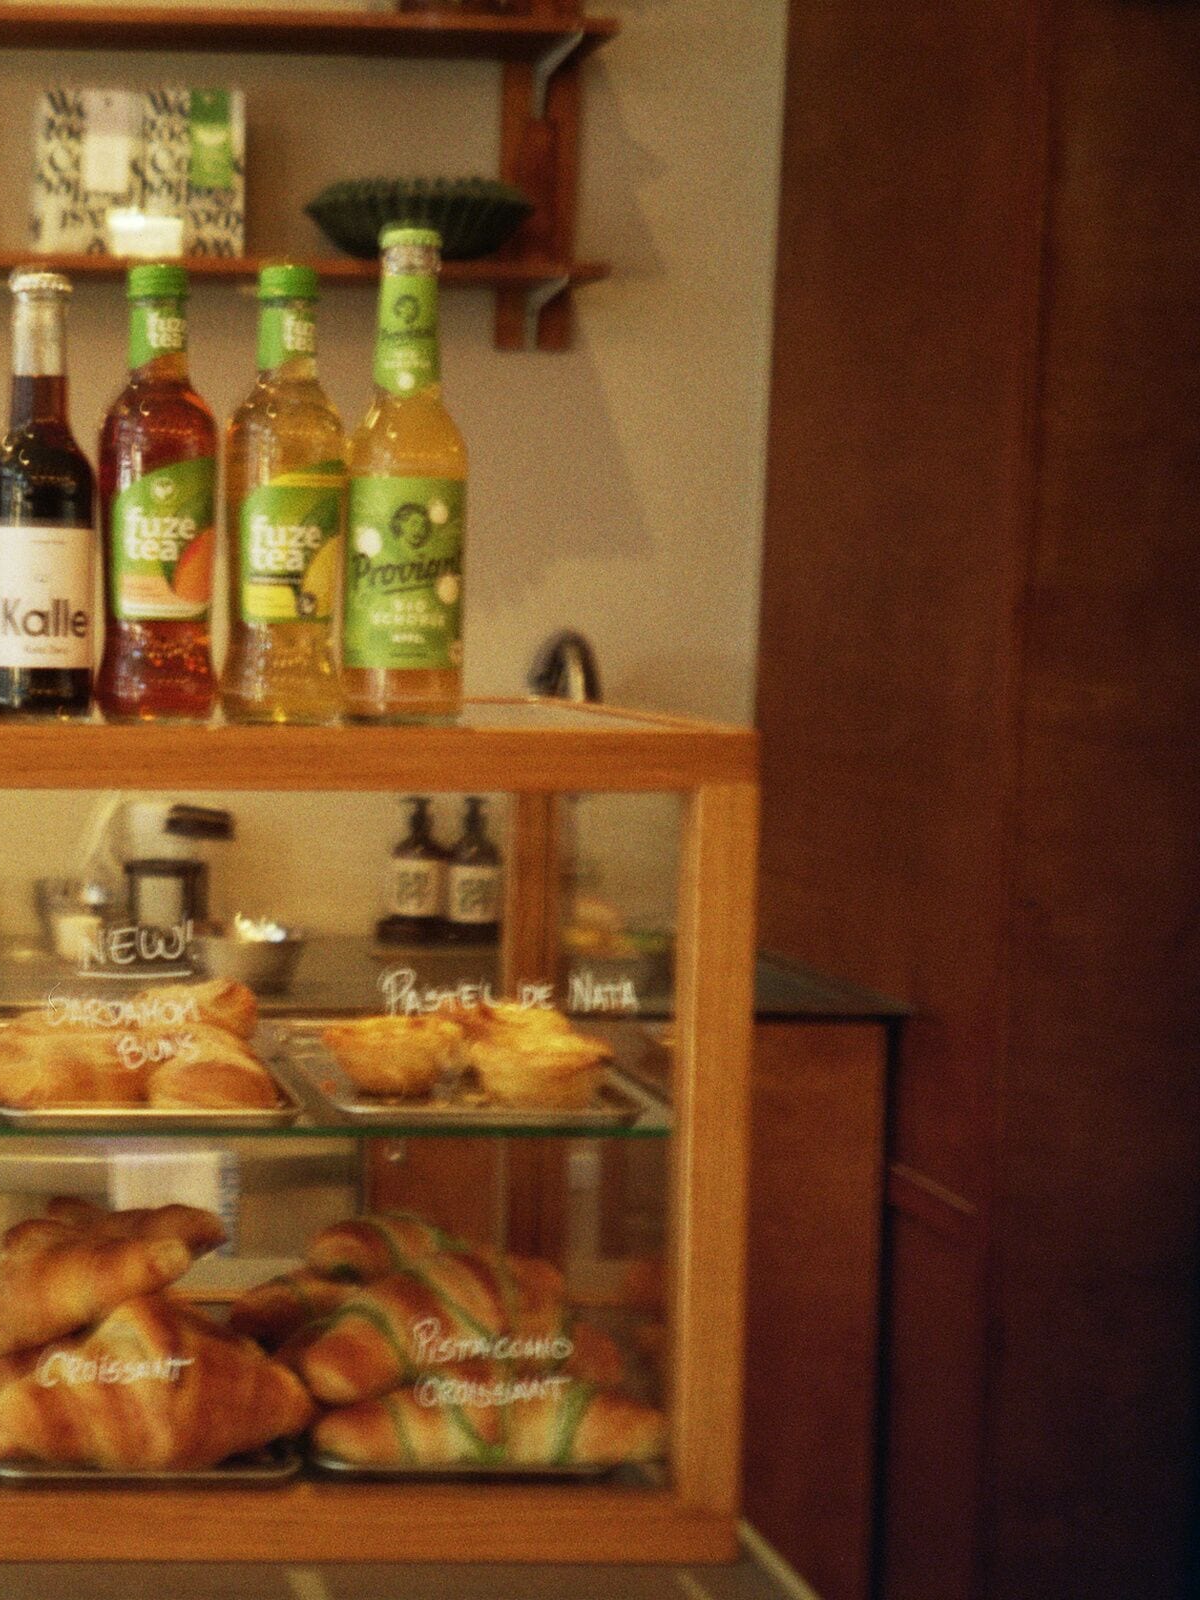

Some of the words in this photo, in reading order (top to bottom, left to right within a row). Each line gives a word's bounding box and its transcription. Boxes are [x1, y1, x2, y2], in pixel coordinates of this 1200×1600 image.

[125, 506, 197, 540] fuze
[250, 514, 322, 550] fuze
[125, 538, 179, 562] tea
[250, 548, 304, 571] tea
[1, 597, 89, 639] Kalle
[80, 919, 199, 970] NEW!
[378, 966, 502, 1017] PASTEL
